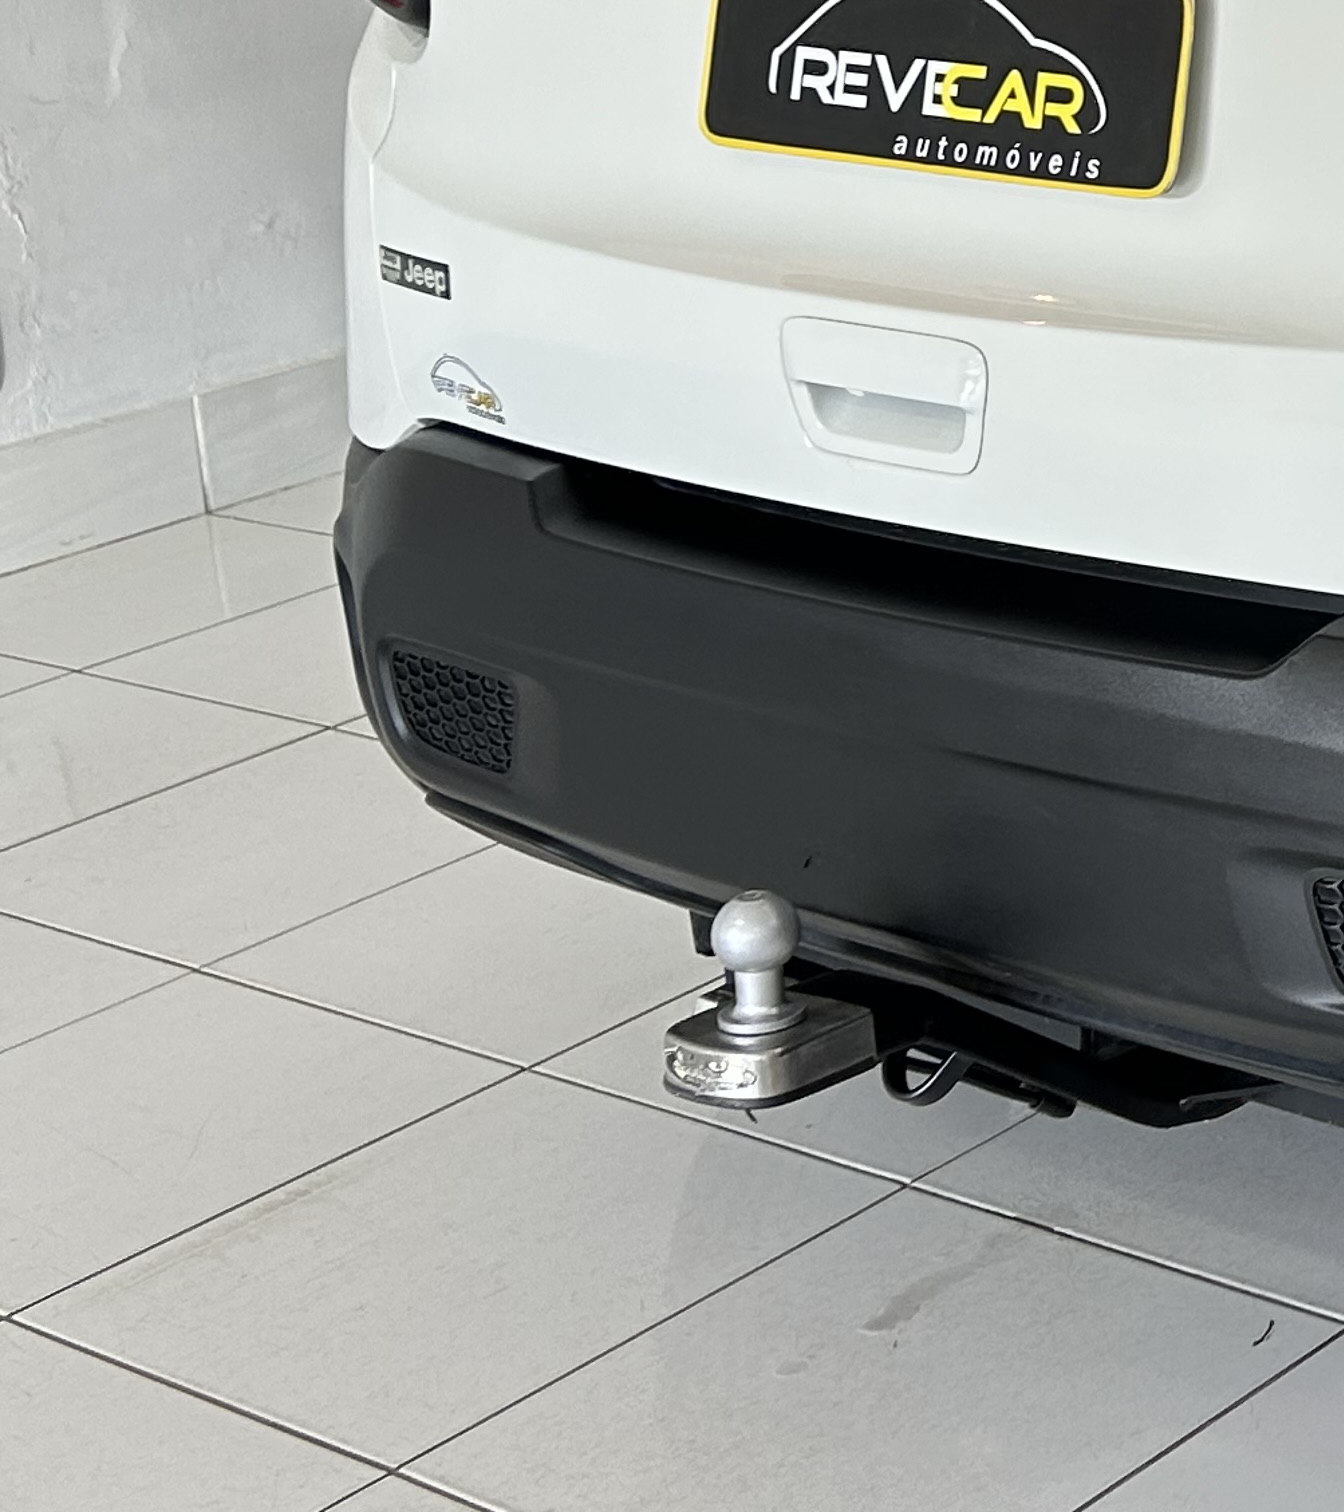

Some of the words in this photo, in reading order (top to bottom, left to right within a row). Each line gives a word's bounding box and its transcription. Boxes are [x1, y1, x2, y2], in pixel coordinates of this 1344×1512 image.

[789, 46, 1086, 136] REVECAR
[892, 134, 1102, 180] automóveis
[403, 257, 447, 297] Jeep
